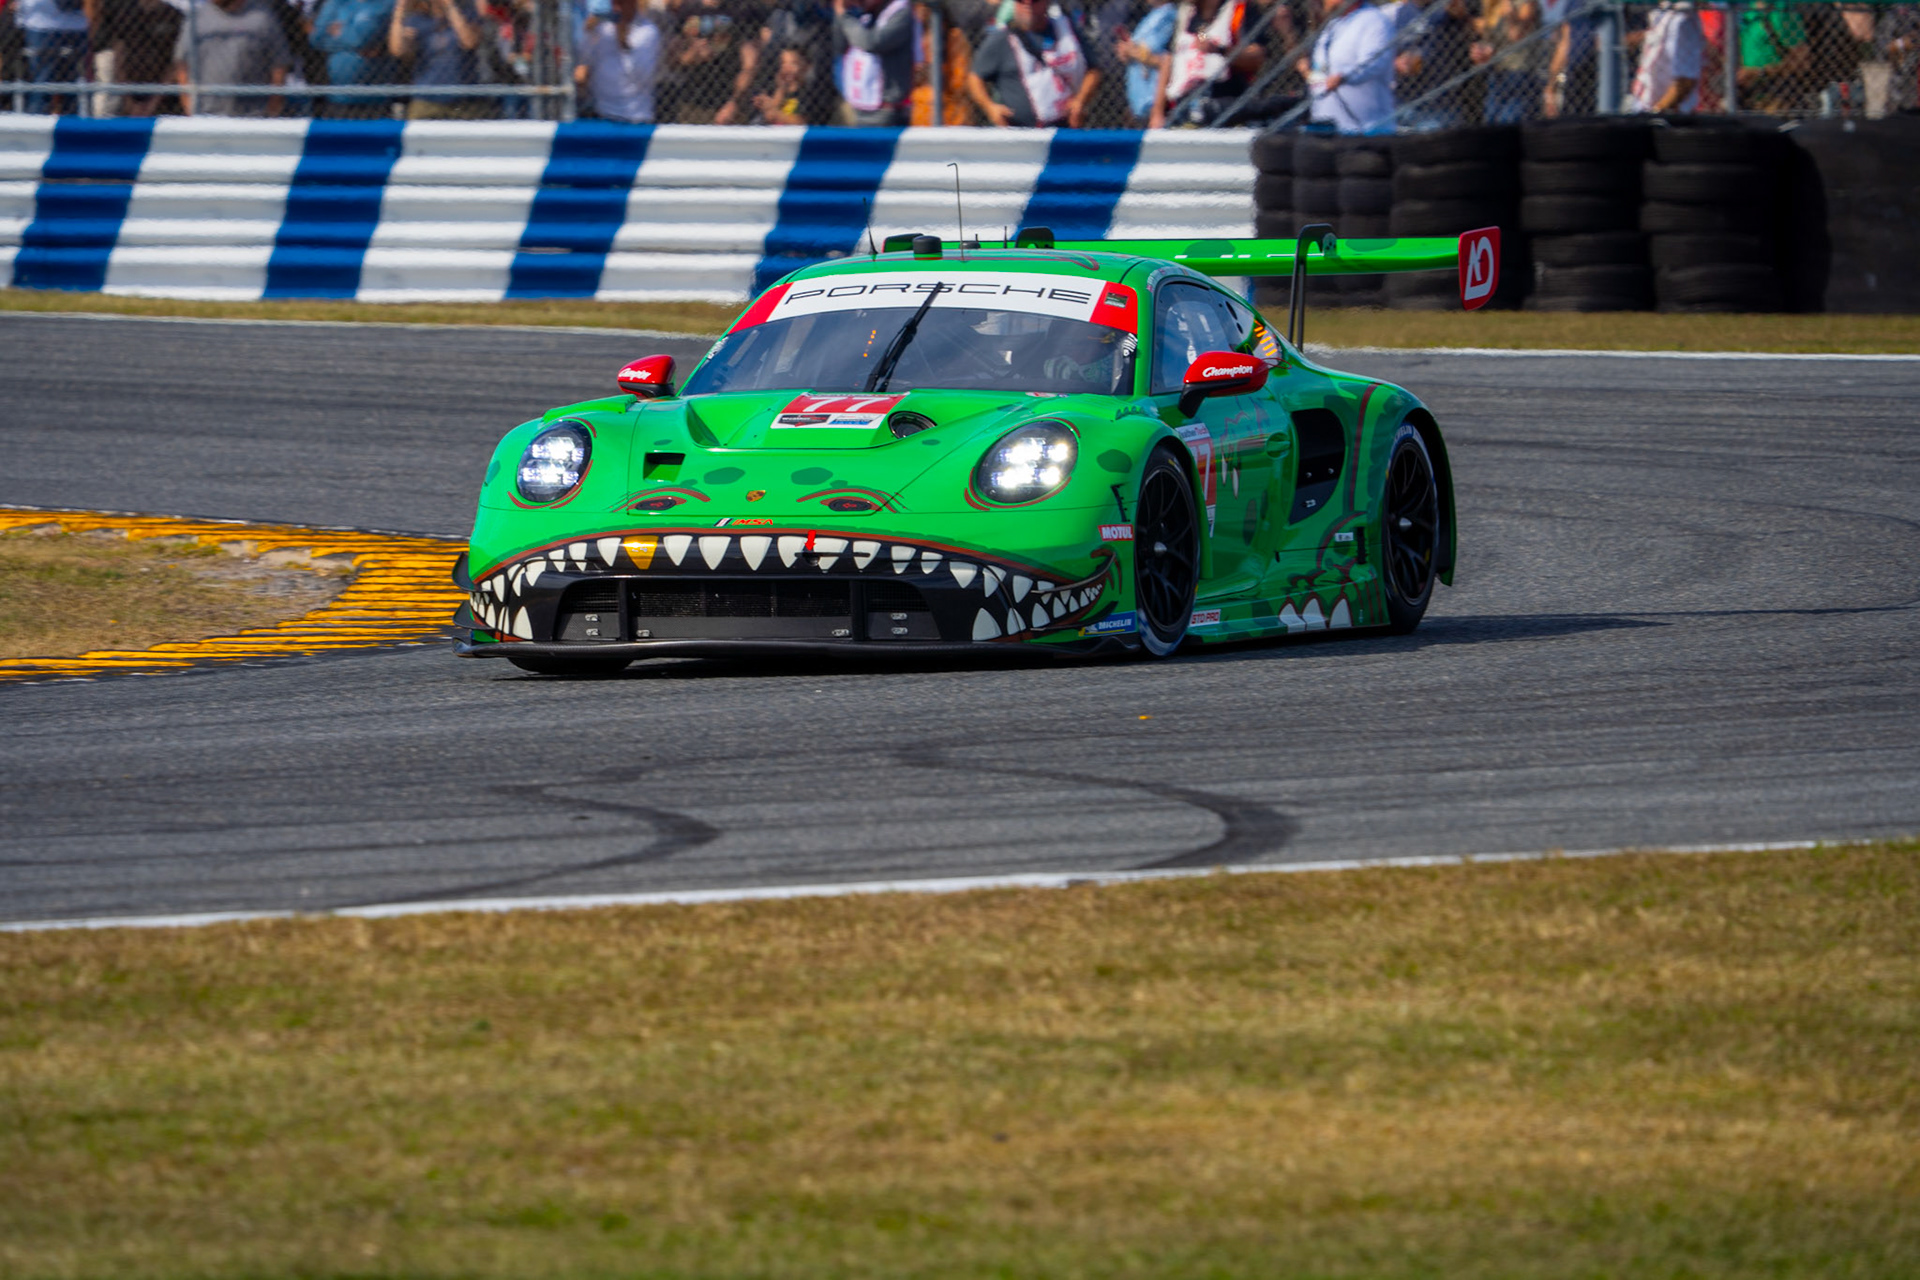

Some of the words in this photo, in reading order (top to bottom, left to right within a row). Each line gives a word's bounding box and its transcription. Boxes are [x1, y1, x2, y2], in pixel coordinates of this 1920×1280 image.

[784, 282, 1092, 305] PORSCHE
[1202, 365, 1253, 378] Champion
[802, 397, 891, 412] 77
[732, 518, 773, 526] IMSA
[1101, 526, 1133, 539] MOTUL
[1098, 618, 1132, 630] MICHELIN
